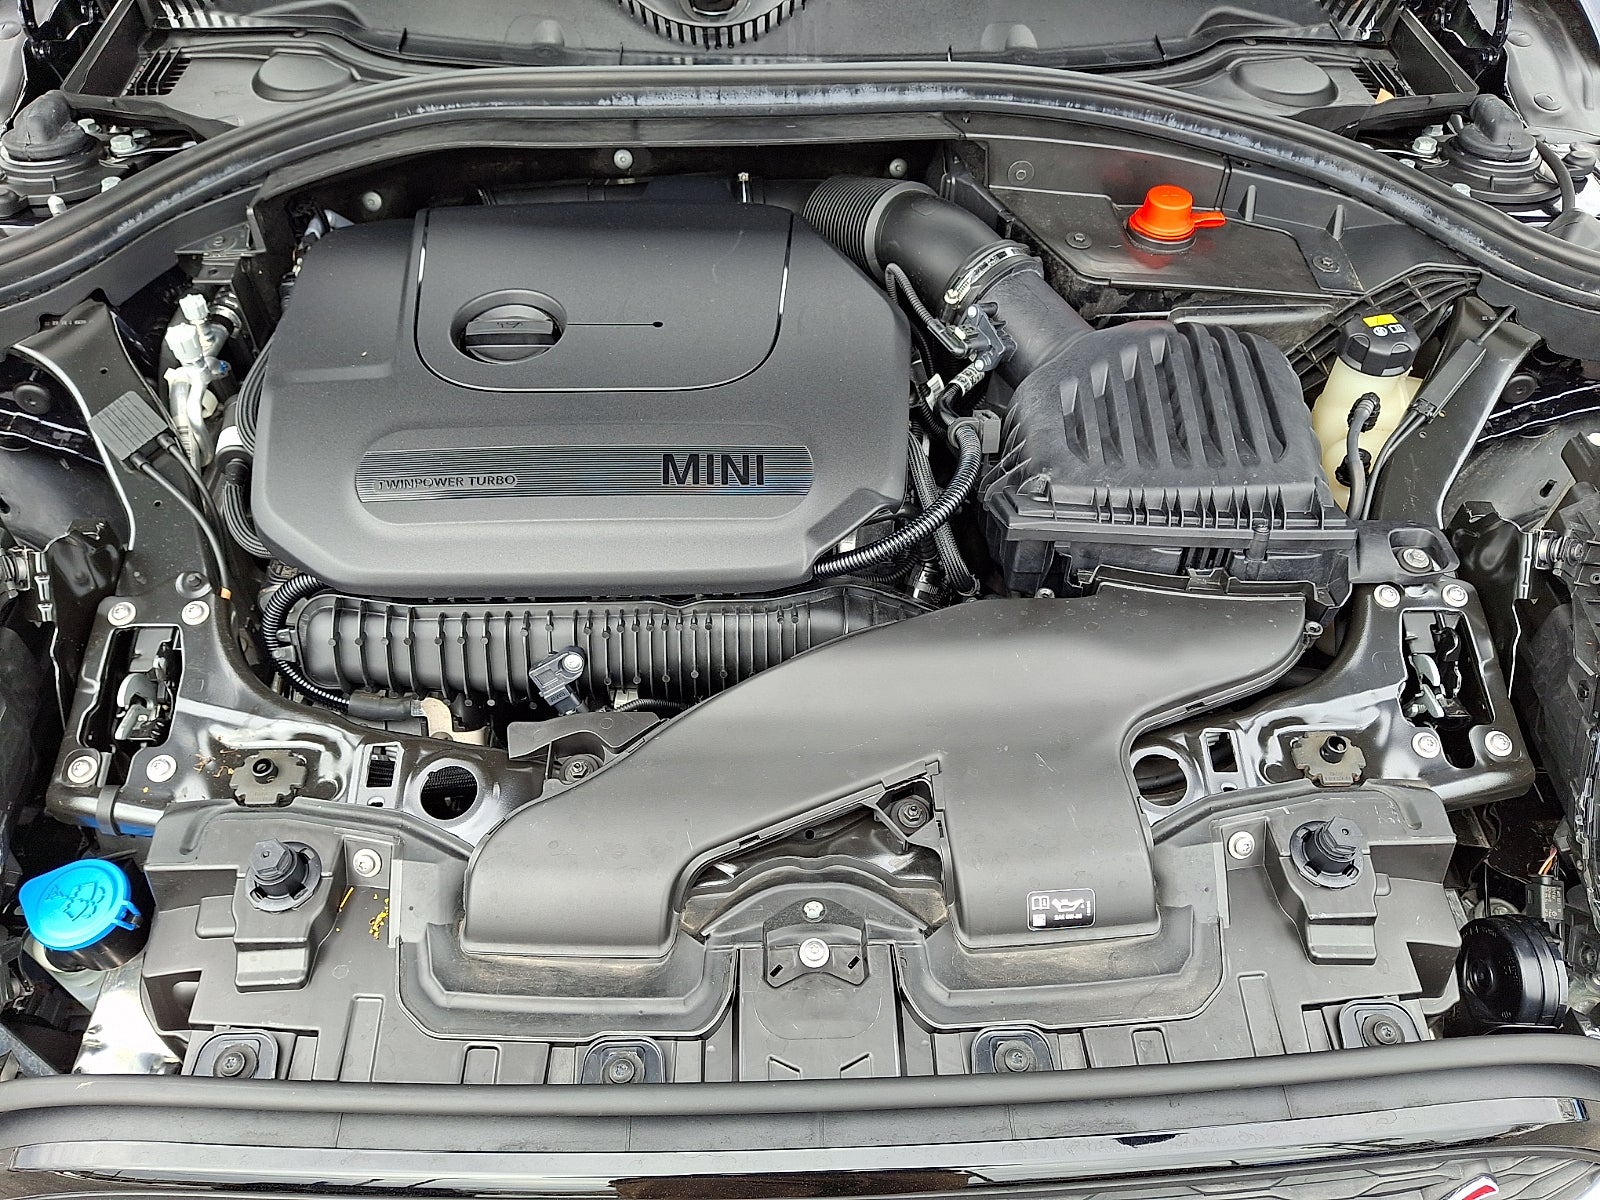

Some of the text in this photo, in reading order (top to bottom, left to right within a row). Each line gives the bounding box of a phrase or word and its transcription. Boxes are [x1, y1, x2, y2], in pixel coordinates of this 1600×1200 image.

[662, 453, 765, 486] MINI
[378, 475, 516, 490] TWINPOWER TURBO
